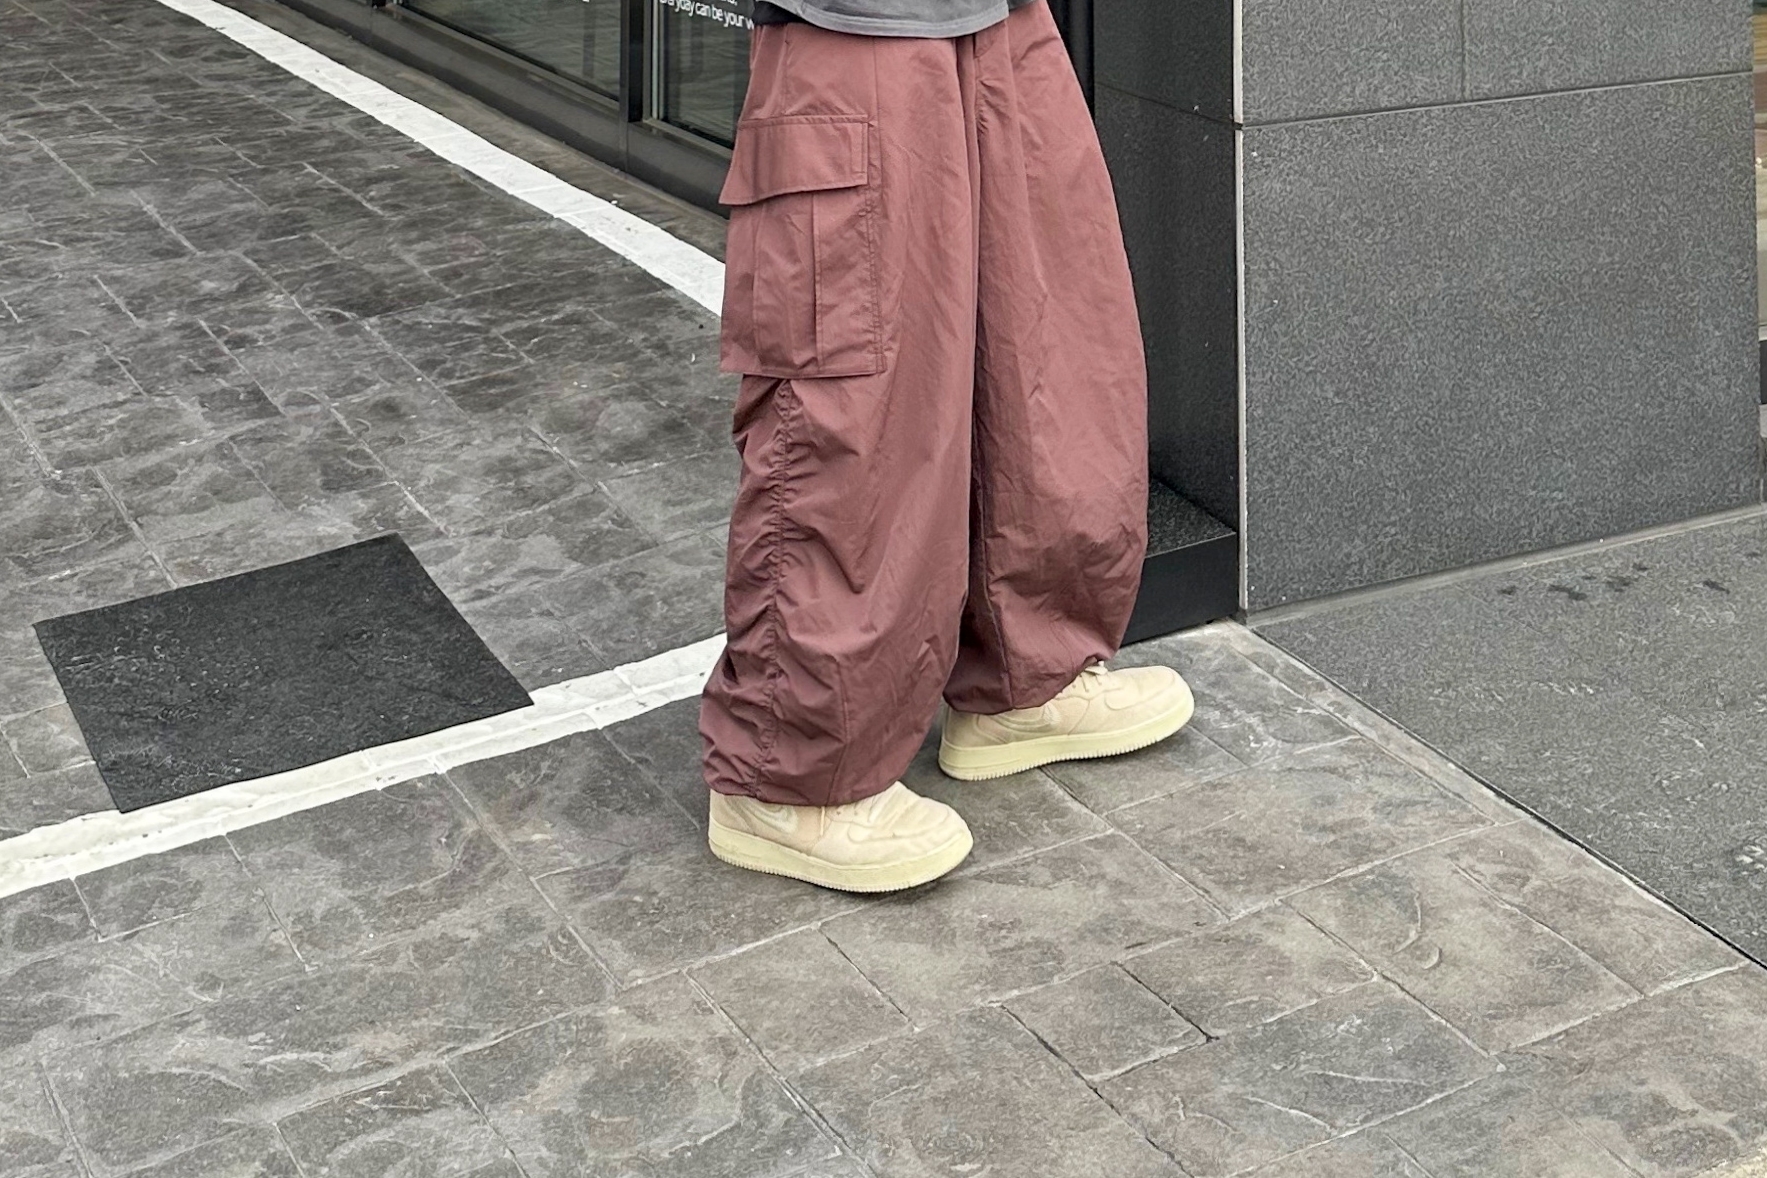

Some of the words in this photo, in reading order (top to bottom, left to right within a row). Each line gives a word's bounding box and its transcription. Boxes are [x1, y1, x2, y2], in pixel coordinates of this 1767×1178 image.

[695, 2, 711, 18] can
[712, 4, 724, 21] be
[723, 11, 744, 28] your
